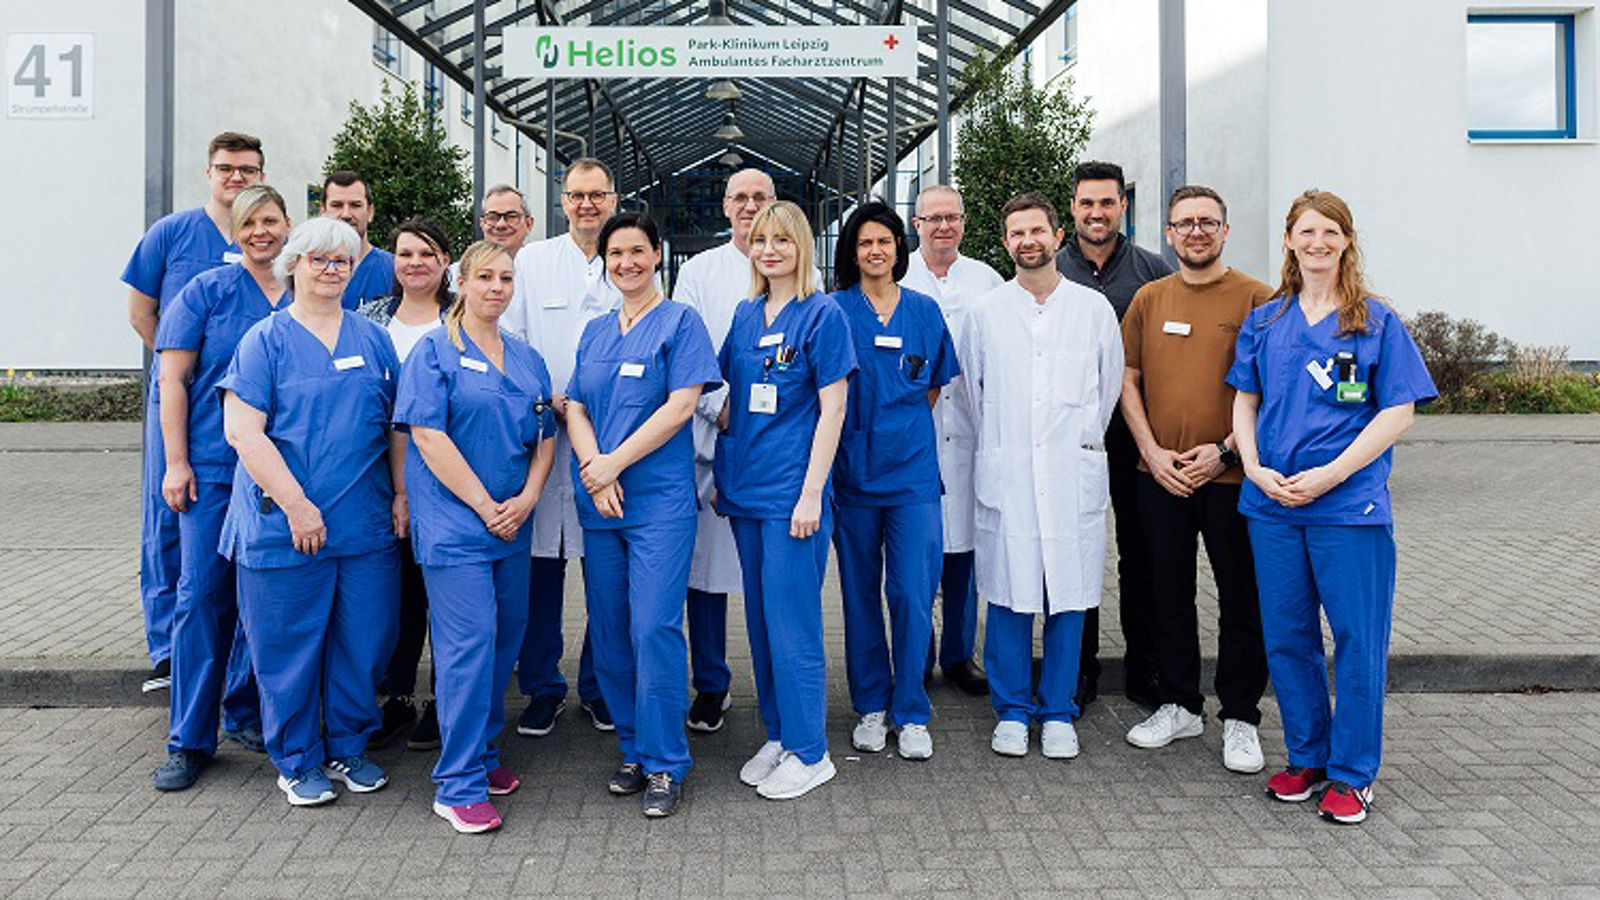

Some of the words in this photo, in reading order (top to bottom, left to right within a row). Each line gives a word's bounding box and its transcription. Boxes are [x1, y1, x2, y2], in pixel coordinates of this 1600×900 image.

[568, 39, 677, 67] Helios
[688, 38, 780, 50] Park-Klinikum
[783, 38, 829, 51] Leipzig
[14, 44, 82, 98] 41
[688, 56, 768, 67] Ambulantes
[772, 56, 884, 67] Facharztzentrum
